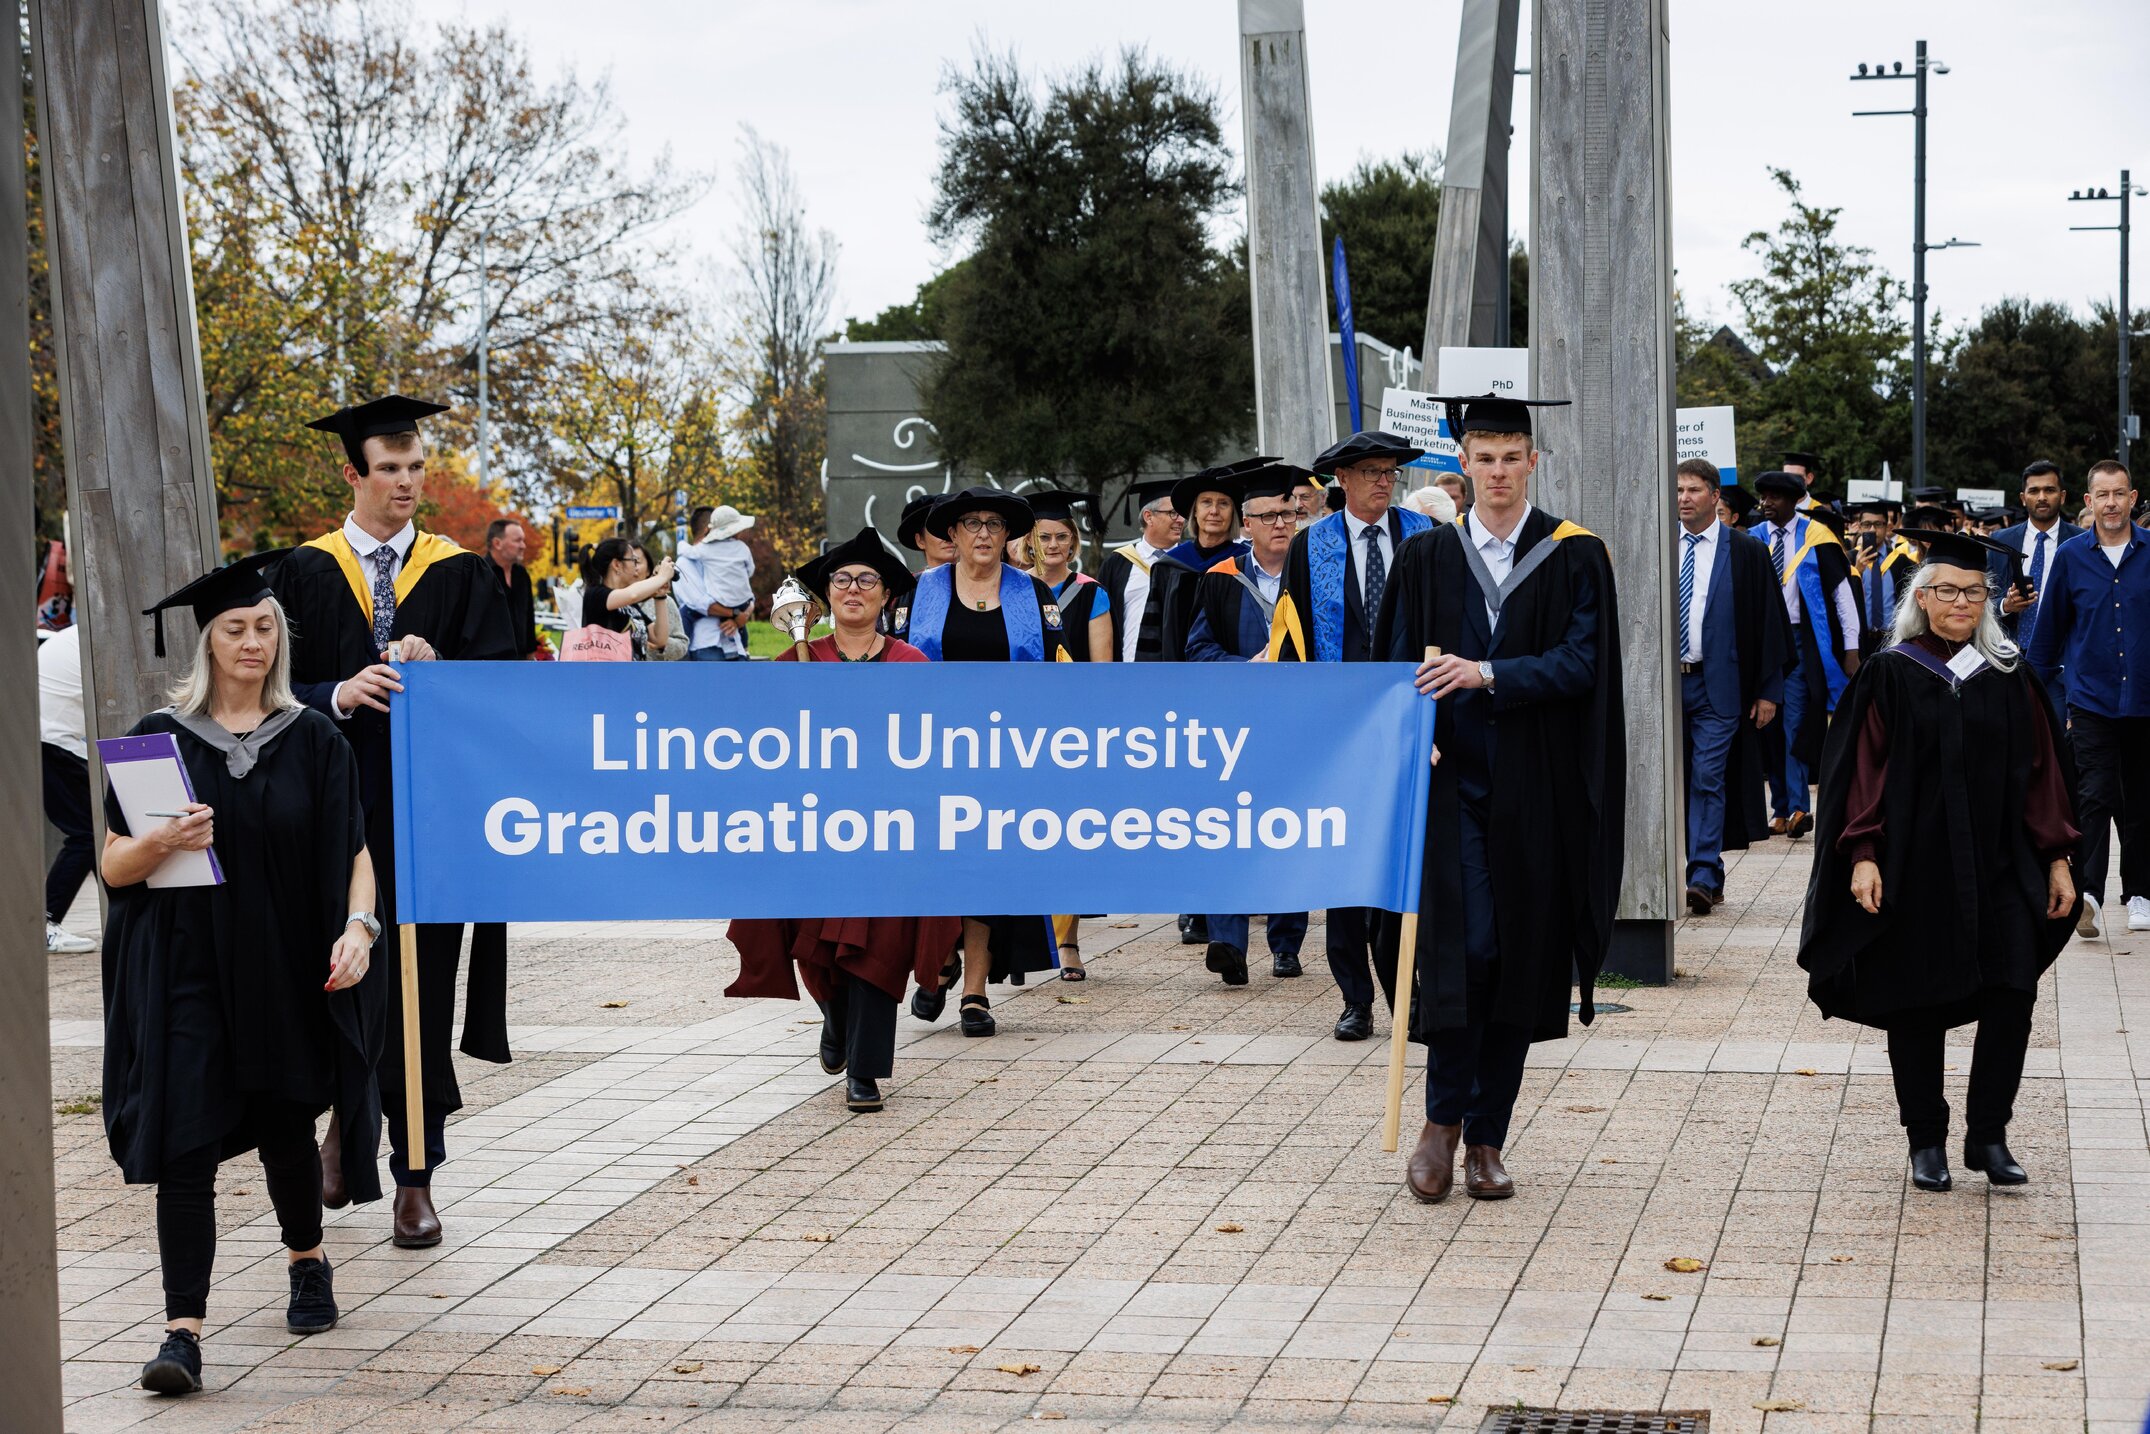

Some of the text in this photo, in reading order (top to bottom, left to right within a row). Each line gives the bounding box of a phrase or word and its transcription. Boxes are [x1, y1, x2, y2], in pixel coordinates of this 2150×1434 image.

[1492, 380, 1514, 390] PhD
[1386, 408, 1432, 423] Business
[1693, 421, 1704, 432] of
[572, 640, 612, 651] REGALIA
[593, 709, 1250, 782] Lincoln University
[484, 791, 1348, 857] Graduation Procession
